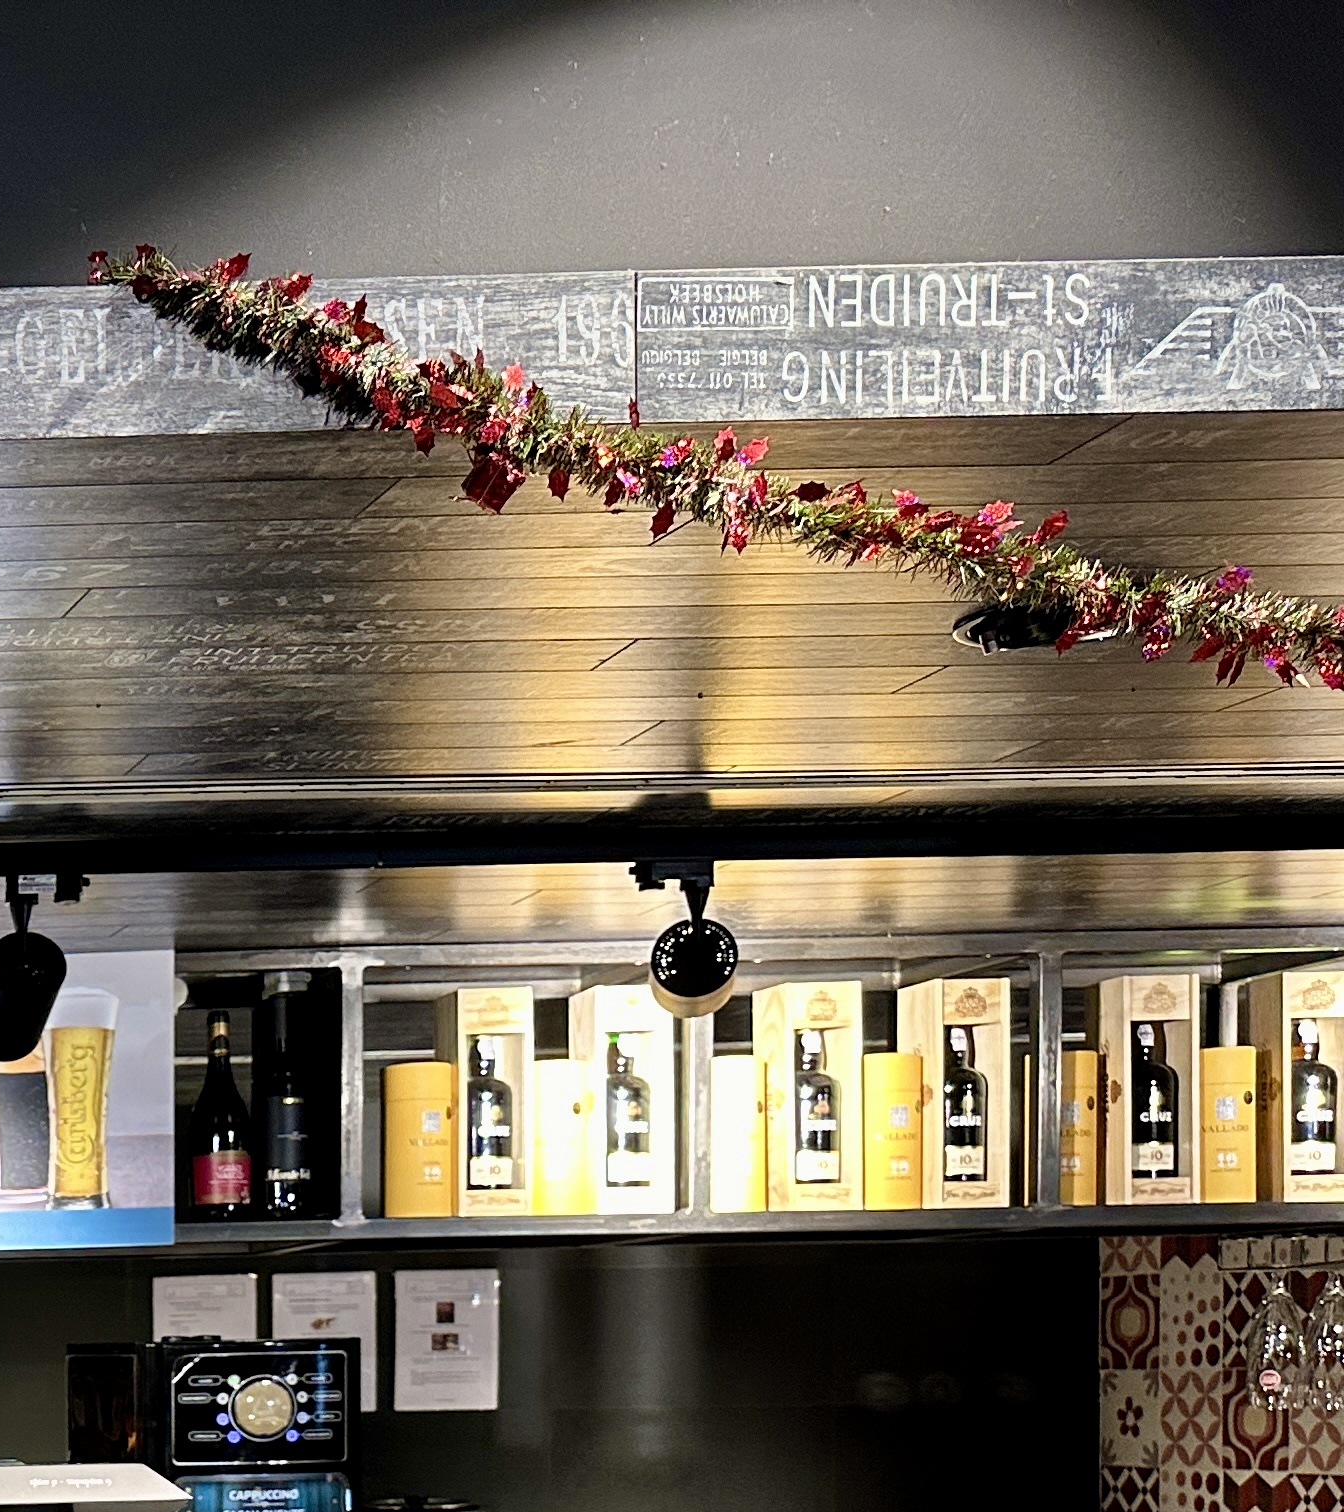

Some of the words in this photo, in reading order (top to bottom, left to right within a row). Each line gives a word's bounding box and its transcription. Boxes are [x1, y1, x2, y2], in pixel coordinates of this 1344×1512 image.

[668, 284, 760, 302] HOLSBEEK
[641, 303, 686, 325] WILLY
[55, 1040, 99, 1167] Carlsberg
[228, 1488, 300, 1502] CAPPUCCINO
